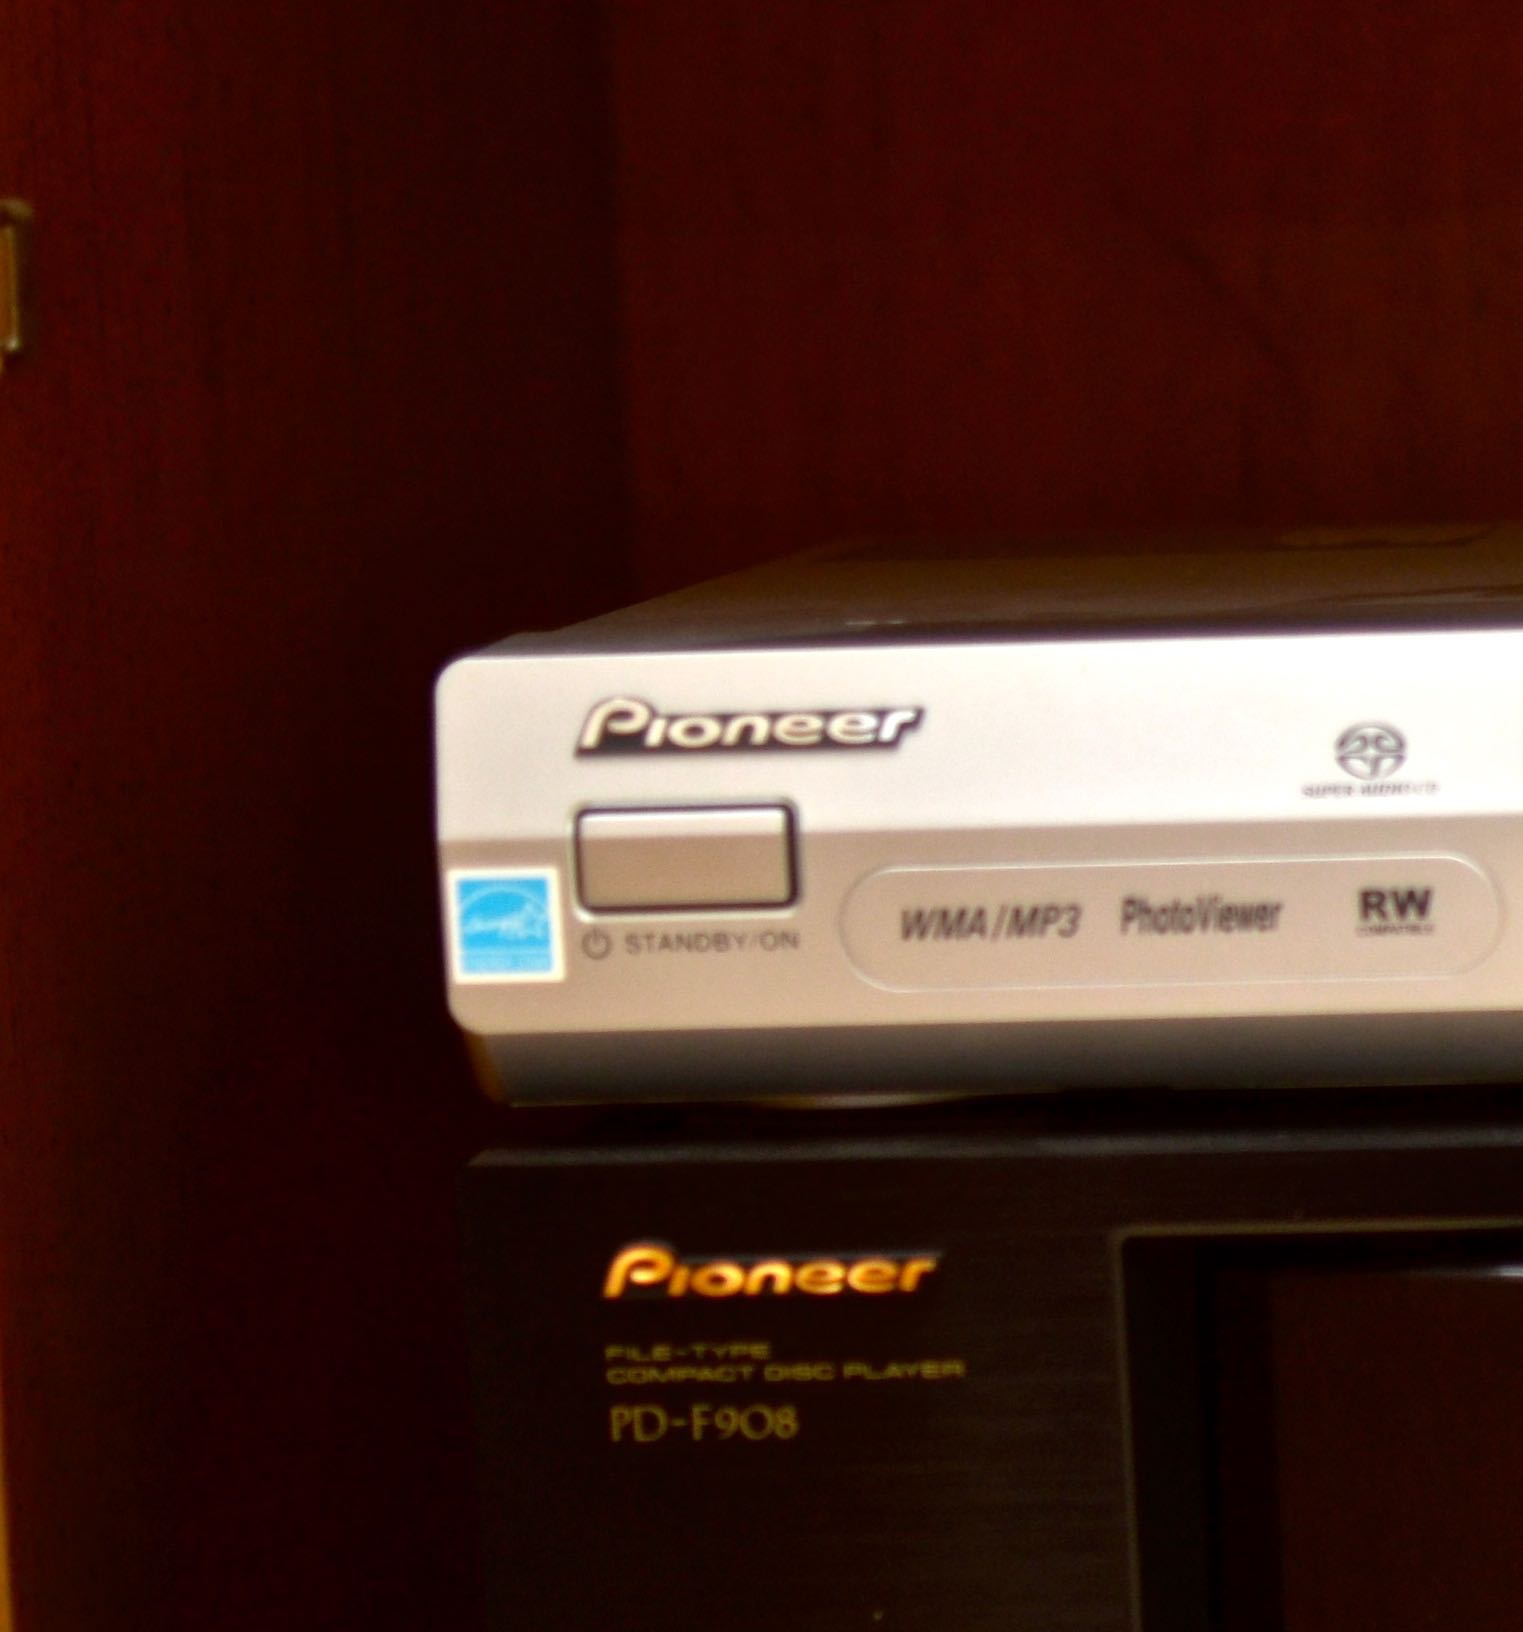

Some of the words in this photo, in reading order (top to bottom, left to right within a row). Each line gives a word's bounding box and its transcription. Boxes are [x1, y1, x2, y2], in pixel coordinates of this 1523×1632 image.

[576, 695, 922, 756] Pioneer
[900, 903, 1083, 942] WMA/MP3
[1120, 894, 1284, 936] PhotoViewer
[1358, 887, 1434, 922] RW
[625, 930, 801, 955] STANDBY/ON
[603, 1241, 940, 1299] Pioneer
[604, 1341, 772, 1362] FILE-TYPE
[606, 1364, 754, 1386] COMPACT
[764, 1363, 834, 1382] DISC
[843, 1359, 967, 1380] PLAYER
[609, 1404, 799, 1442] PD-F908
